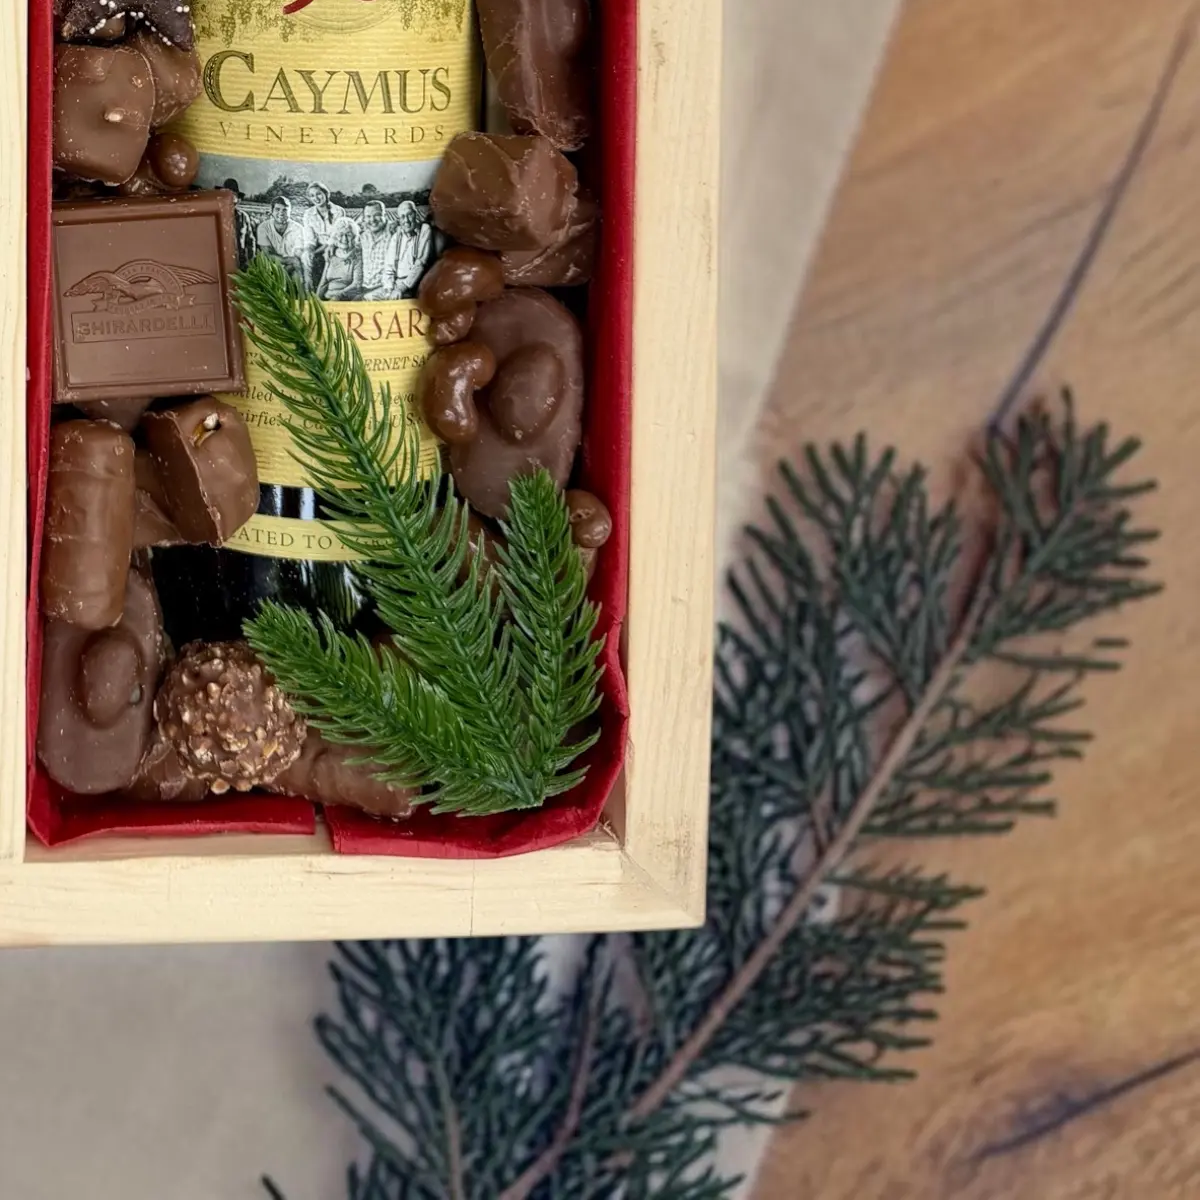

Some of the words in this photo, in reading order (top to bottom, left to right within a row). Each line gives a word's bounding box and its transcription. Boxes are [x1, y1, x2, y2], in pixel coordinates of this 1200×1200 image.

[202, 49, 452, 115] CAYMUS
[218, 121, 446, 145] VINEYARDS
[77, 314, 213, 337] GHIRARDELLI
[231, 526, 295, 547] ATED
[301, 534, 333, 550] TO
